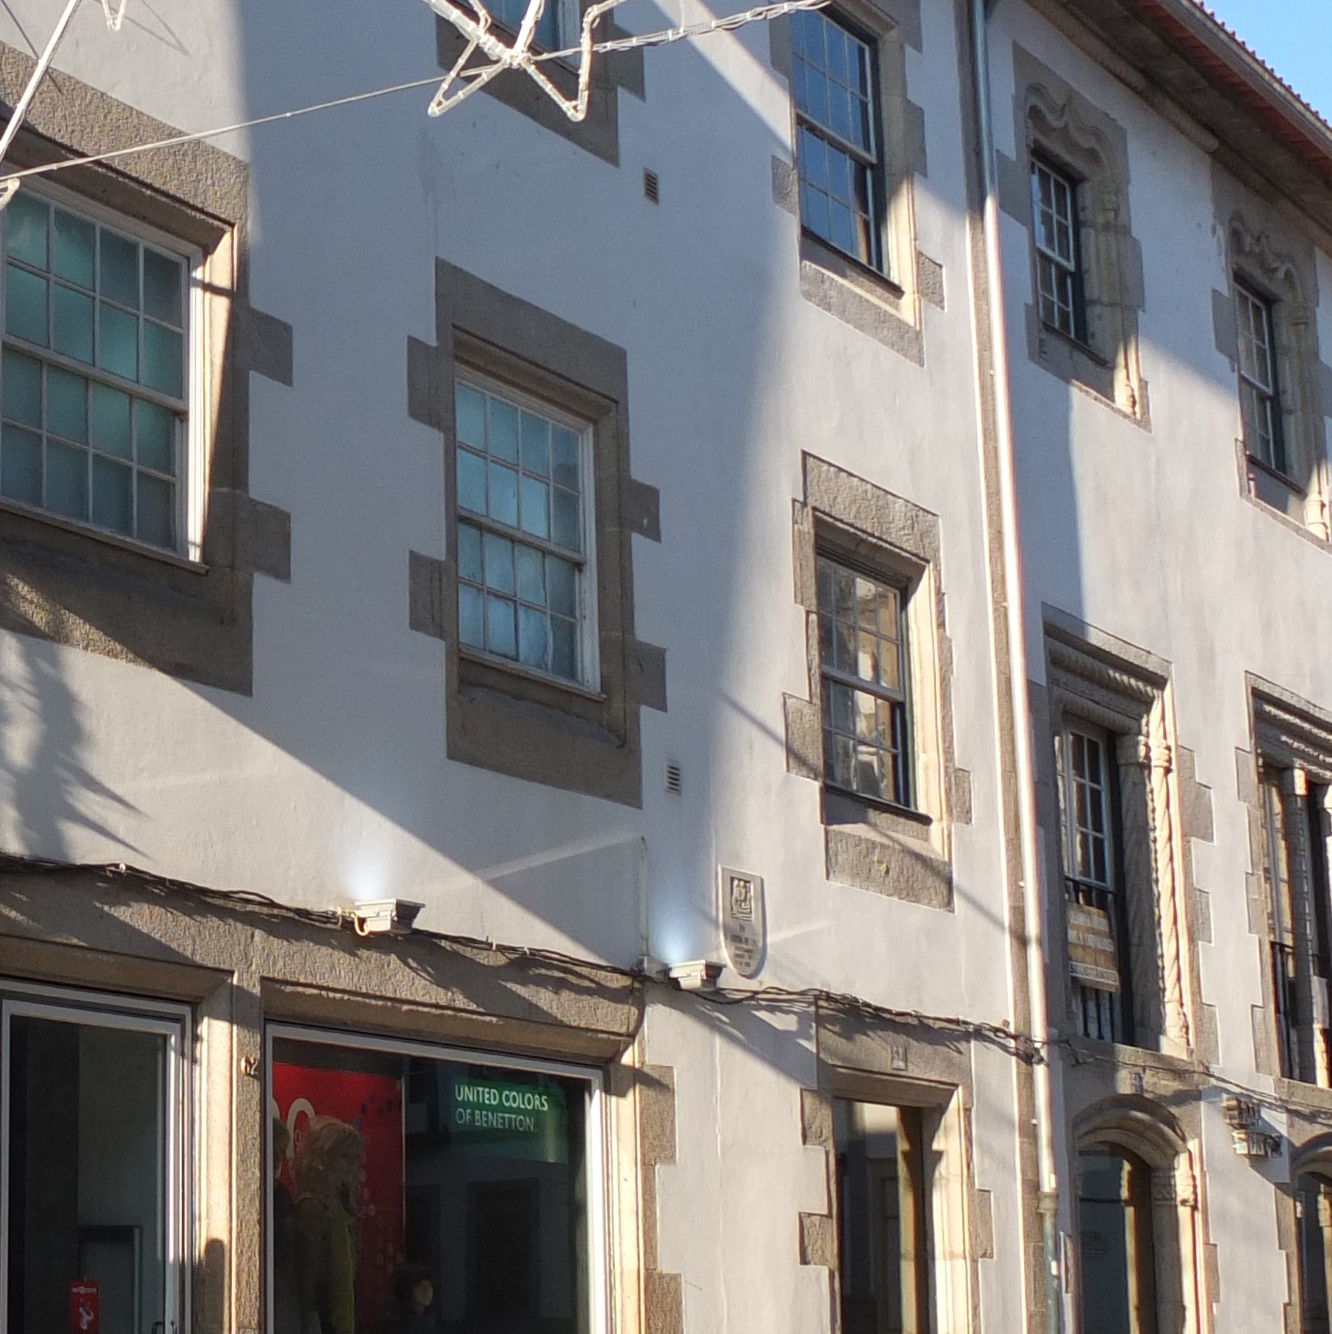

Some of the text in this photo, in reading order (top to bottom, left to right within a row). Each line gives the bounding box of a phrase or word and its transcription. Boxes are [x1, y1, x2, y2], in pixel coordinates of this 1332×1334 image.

[455, 1084, 549, 1111] UNITED COLORS
[455, 1108, 472, 1124] OF
